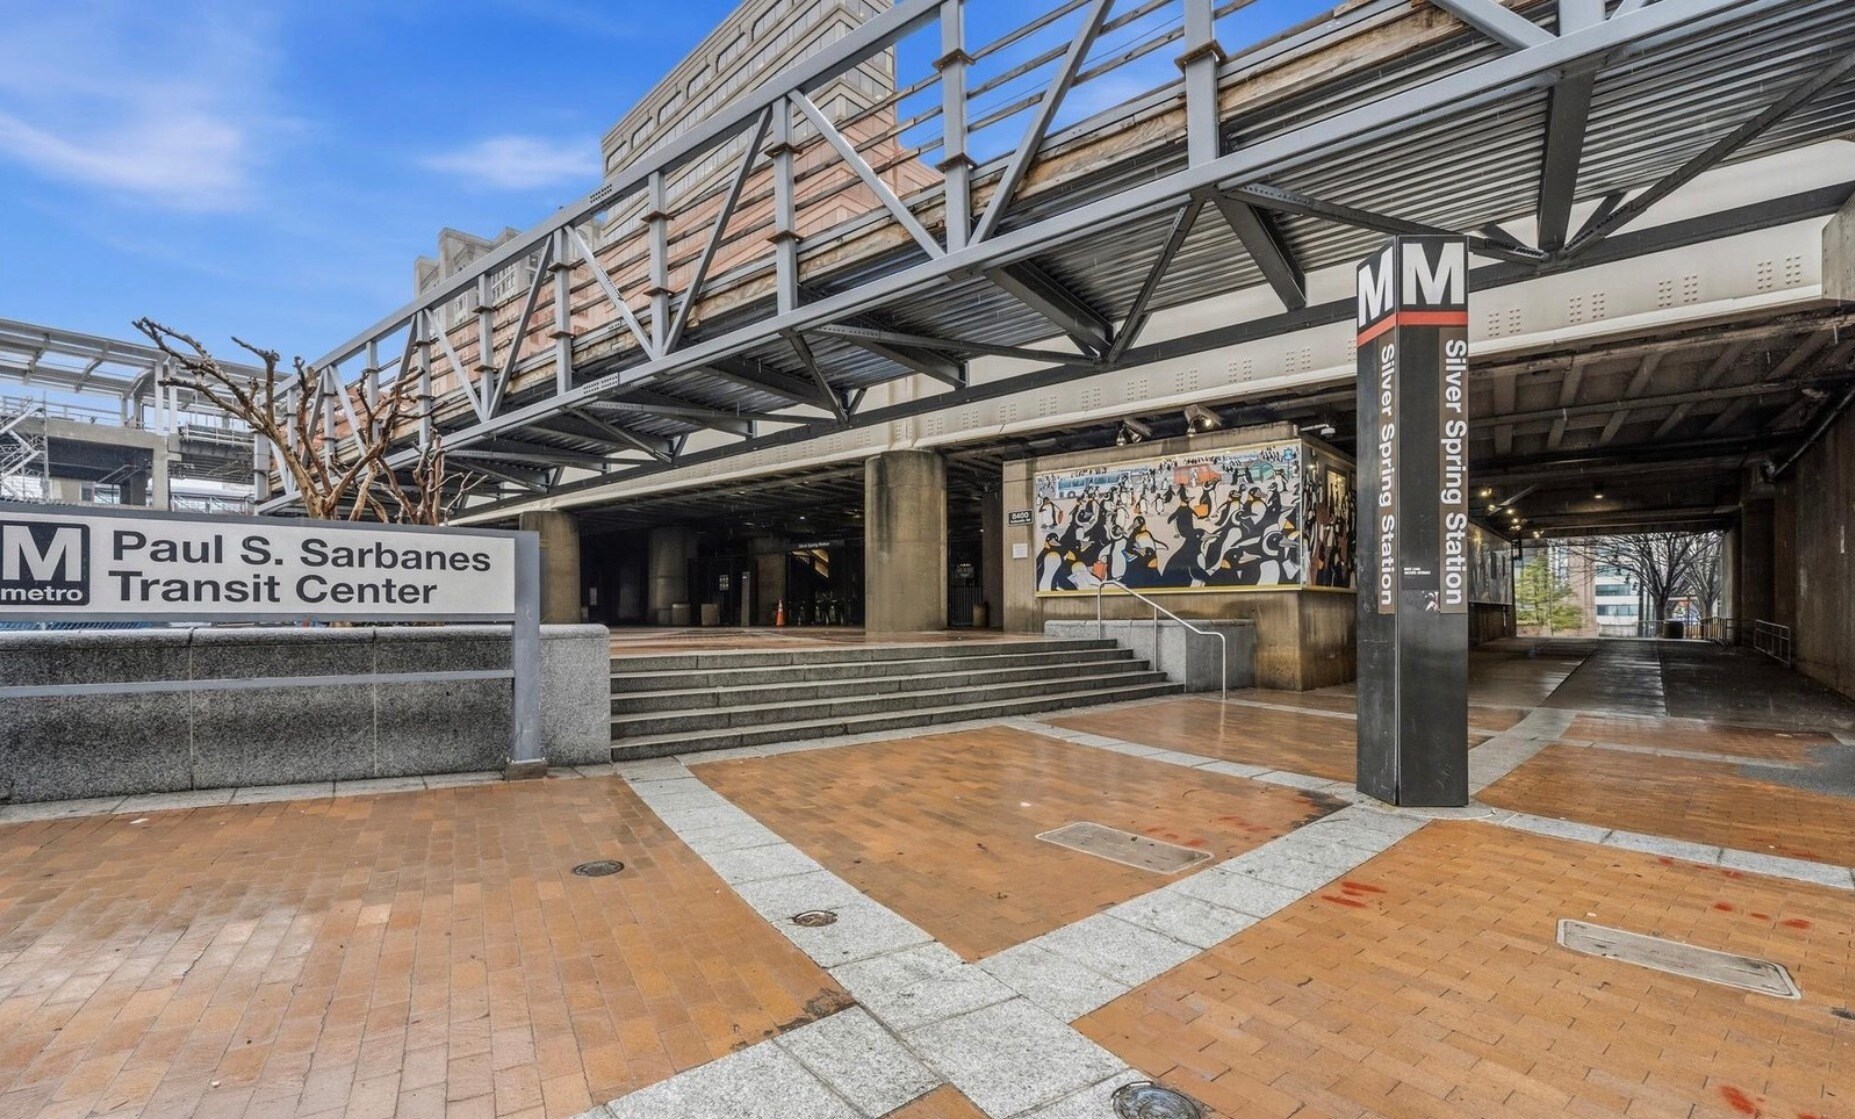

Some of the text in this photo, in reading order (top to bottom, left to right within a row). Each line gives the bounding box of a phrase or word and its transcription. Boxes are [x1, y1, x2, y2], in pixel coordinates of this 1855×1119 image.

[1358, 246, 1394, 329] M
[1402, 242, 1465, 305] M
[1378, 343, 1395, 605] Silver Spring Station
[1440, 339, 1467, 604] Silver Spring Station
[2, 525, 82, 582] M
[113, 529, 491, 572] Paul S. Sarbanes
[0, 585, 83, 602] metro
[108, 570, 437, 604] Transit Center
